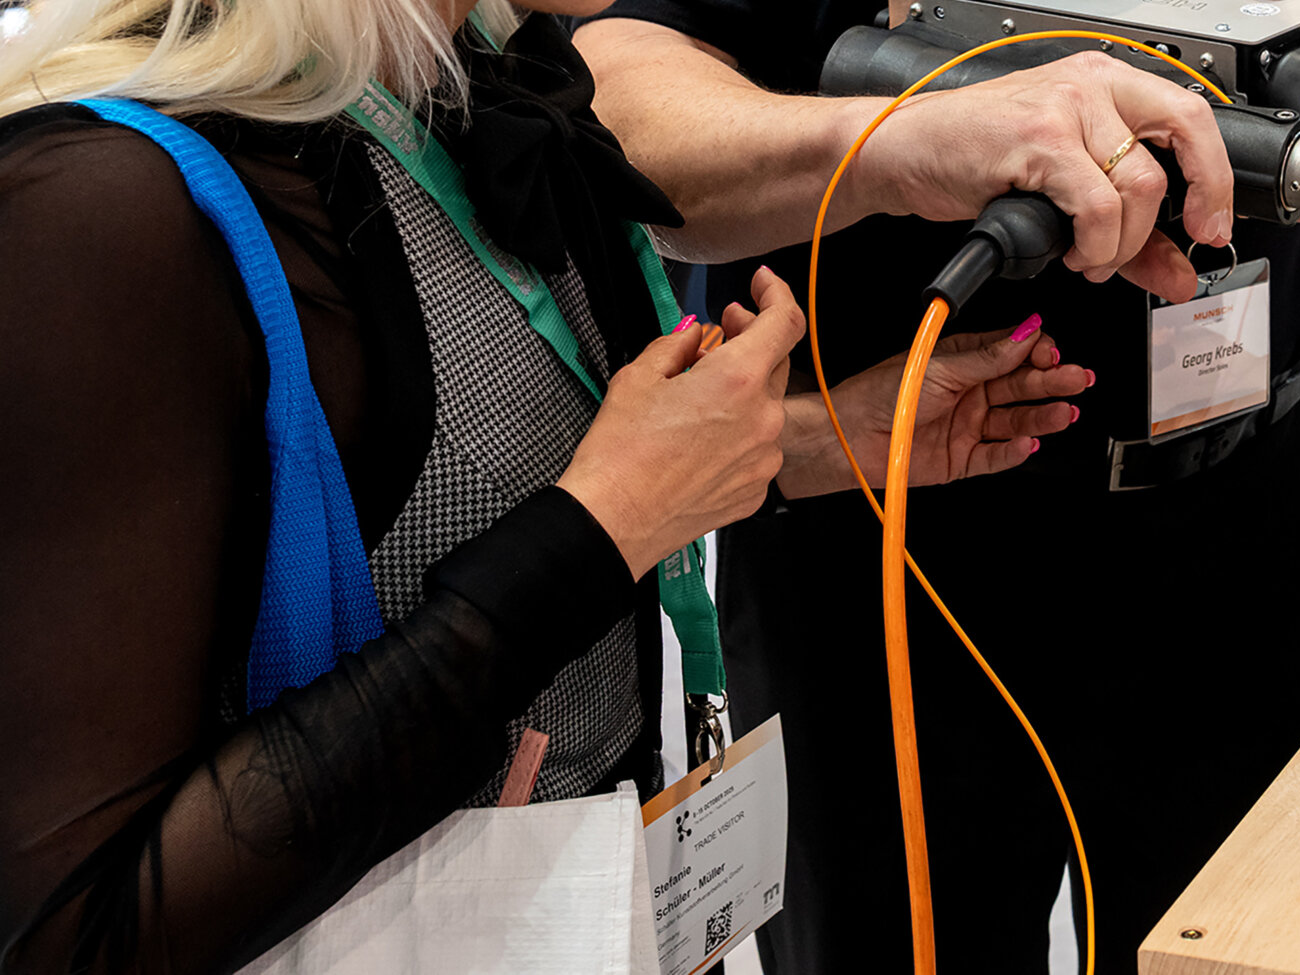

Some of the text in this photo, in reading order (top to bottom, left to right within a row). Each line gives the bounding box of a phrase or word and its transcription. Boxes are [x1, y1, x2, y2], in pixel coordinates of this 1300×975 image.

[1193, 305, 1234, 321] MUNSCH
[1182, 341, 1244, 369] Georg Krebs
[694, 810, 745, 852] TRADE VISITOR
[654, 865, 692, 899] Stefanie
[655, 888, 691, 921] Schüler
[698, 862, 726, 889] Müller
